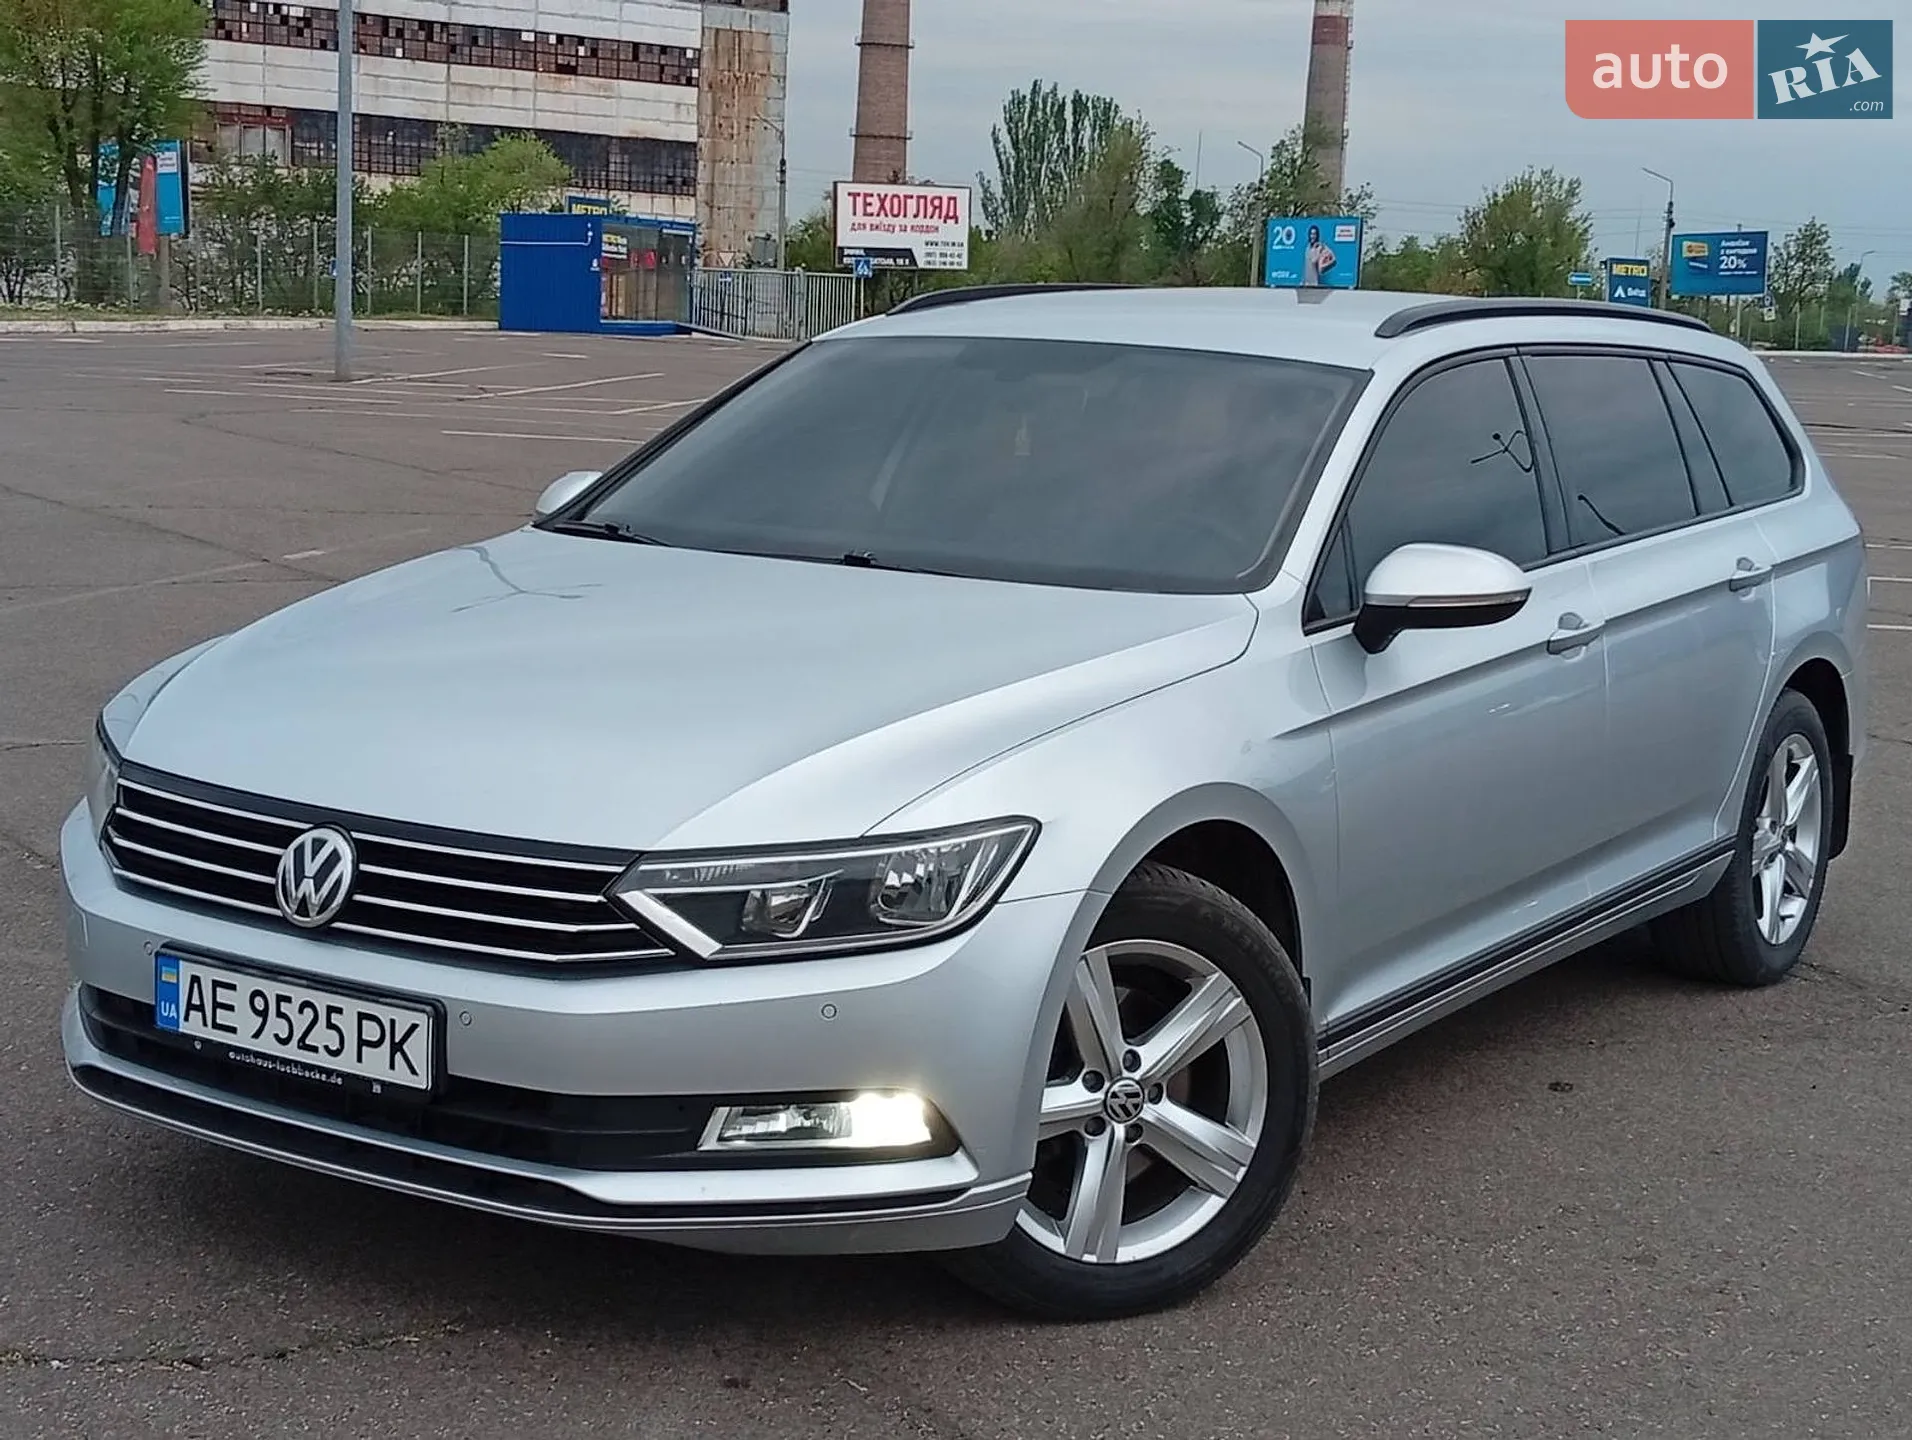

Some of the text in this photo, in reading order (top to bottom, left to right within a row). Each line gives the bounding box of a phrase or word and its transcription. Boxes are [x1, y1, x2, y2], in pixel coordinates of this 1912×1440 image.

[847, 192, 959, 225] ТЕХОГЛЯД
[850, 222, 867, 233] для
[1612, 263, 1648, 276] METRO
[1719, 256, 1747, 269] 20%
[160, 1001, 179, 1020] UA
[182, 973, 421, 1077] AE 9525 PK
